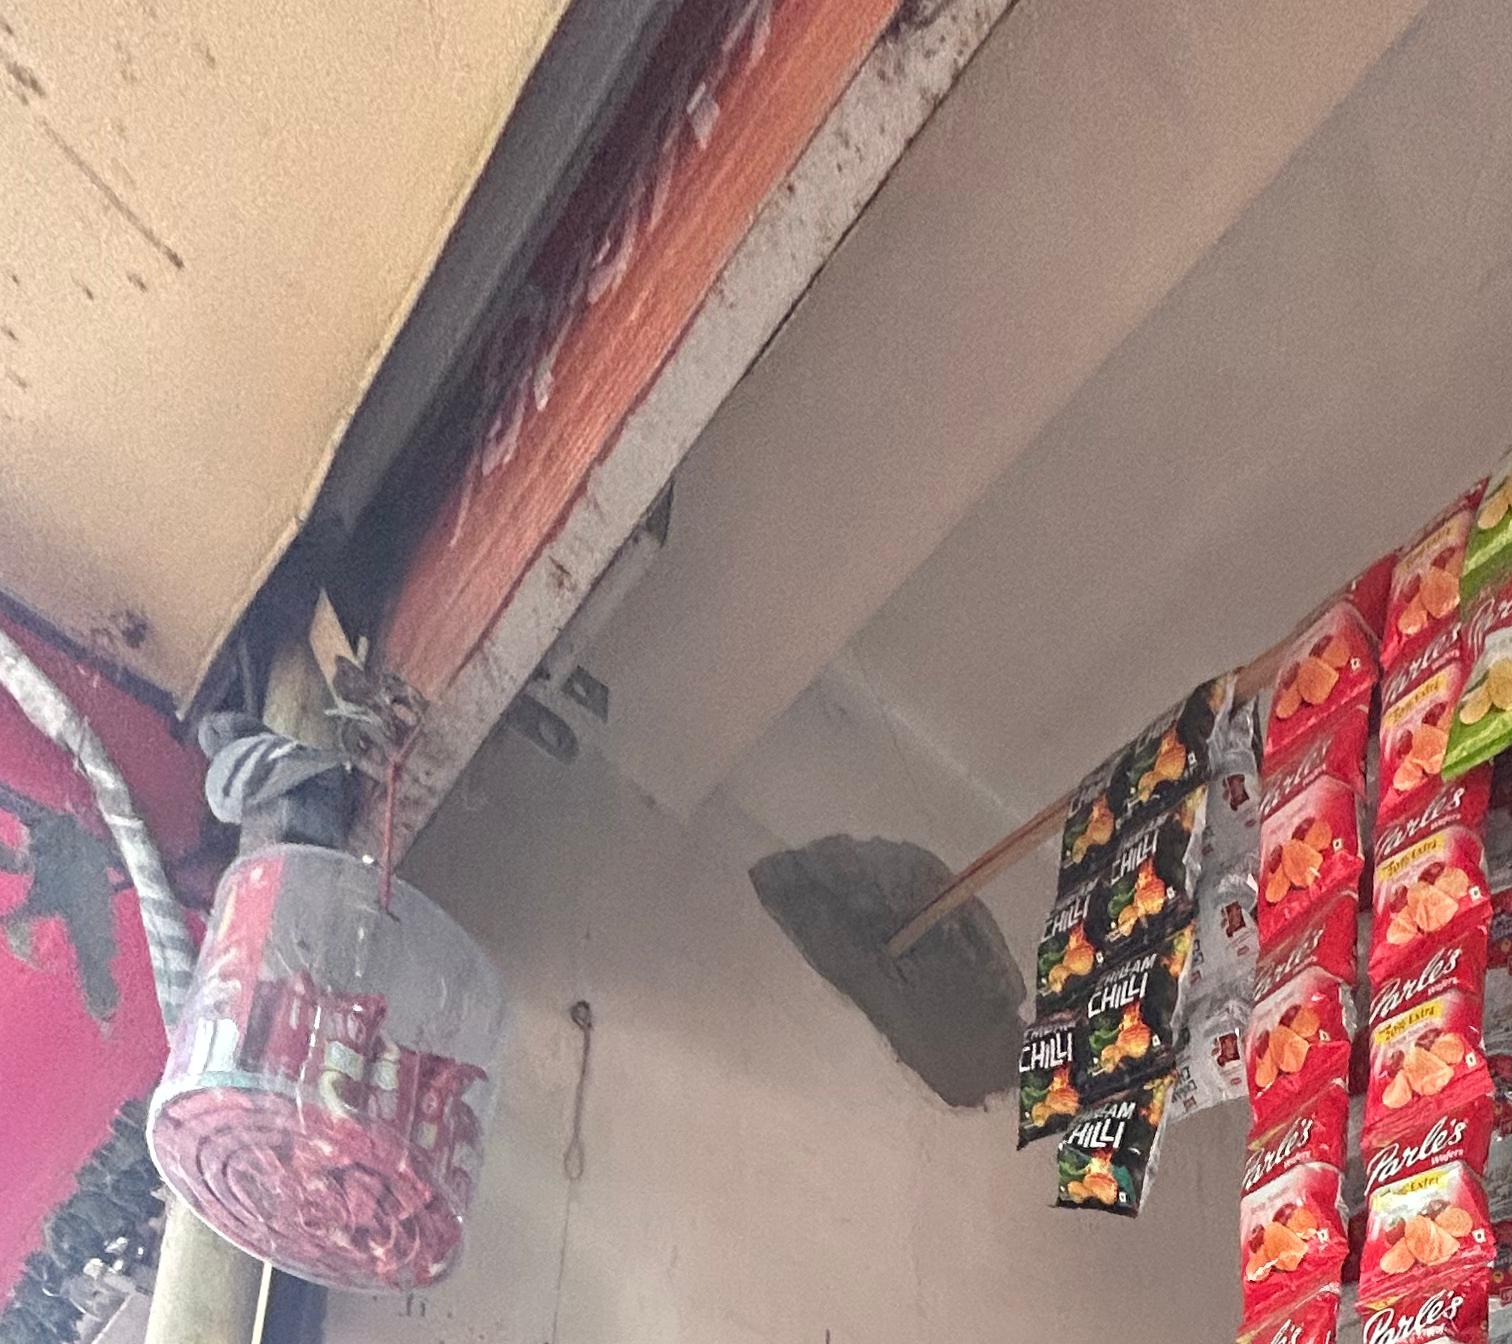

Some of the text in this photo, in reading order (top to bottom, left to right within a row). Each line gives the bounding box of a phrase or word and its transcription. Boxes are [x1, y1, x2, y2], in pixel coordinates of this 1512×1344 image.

[1088, 971, 1149, 1020] CHILLI
[1369, 948, 1462, 1024] Parle's
[1018, 1032, 1073, 1073] CHILLI
[1365, 1115, 1468, 1196] Parle's
